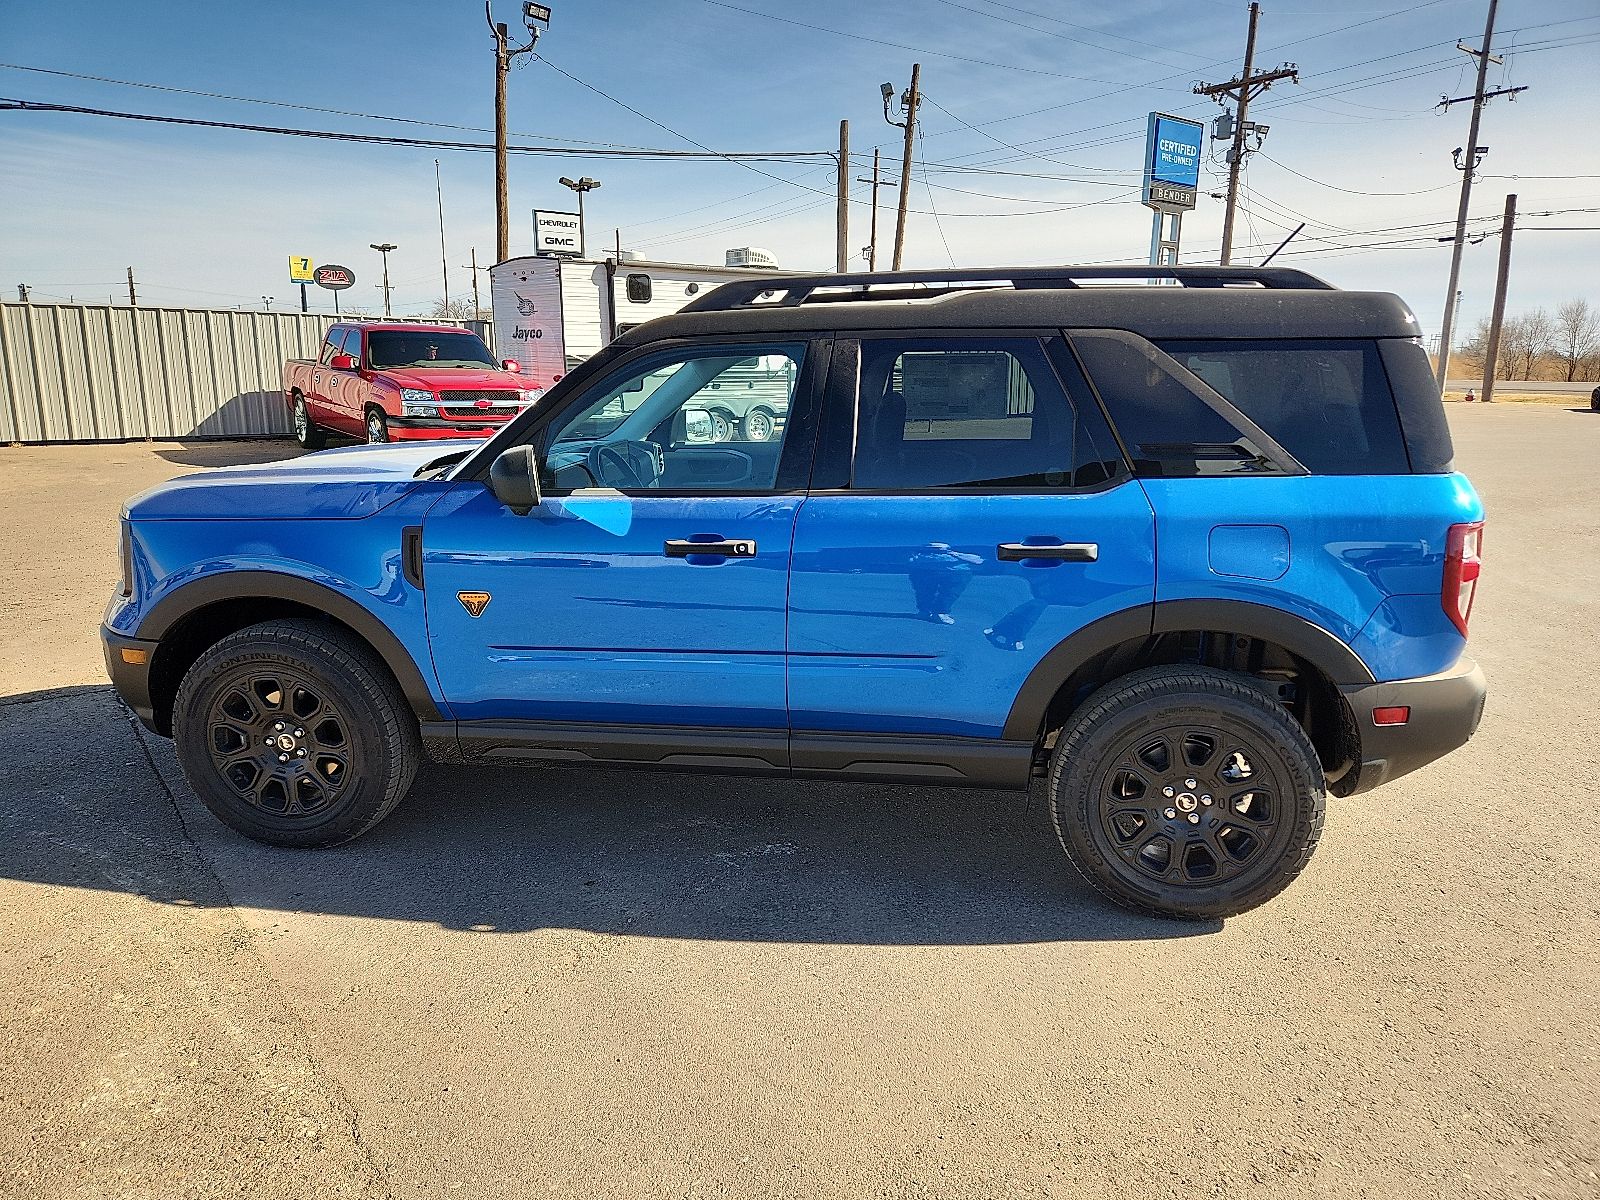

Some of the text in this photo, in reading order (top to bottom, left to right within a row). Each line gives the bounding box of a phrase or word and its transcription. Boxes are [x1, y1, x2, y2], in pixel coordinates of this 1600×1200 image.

[1159, 139, 1197, 157] CERTIFIED
[1161, 152, 1193, 166] PRE-OWNED
[1158, 188, 1191, 203] BENDER
[539, 219, 578, 229] CHEVROLET
[544, 237, 574, 246] GMC
[300, 258, 309, 271] 7
[318, 269, 349, 282] ZIA
[511, 325, 542, 342] Jayco
[211, 652, 315, 675] CONTINENTAL
[1279, 747, 1309, 860] CONTINENTAL
